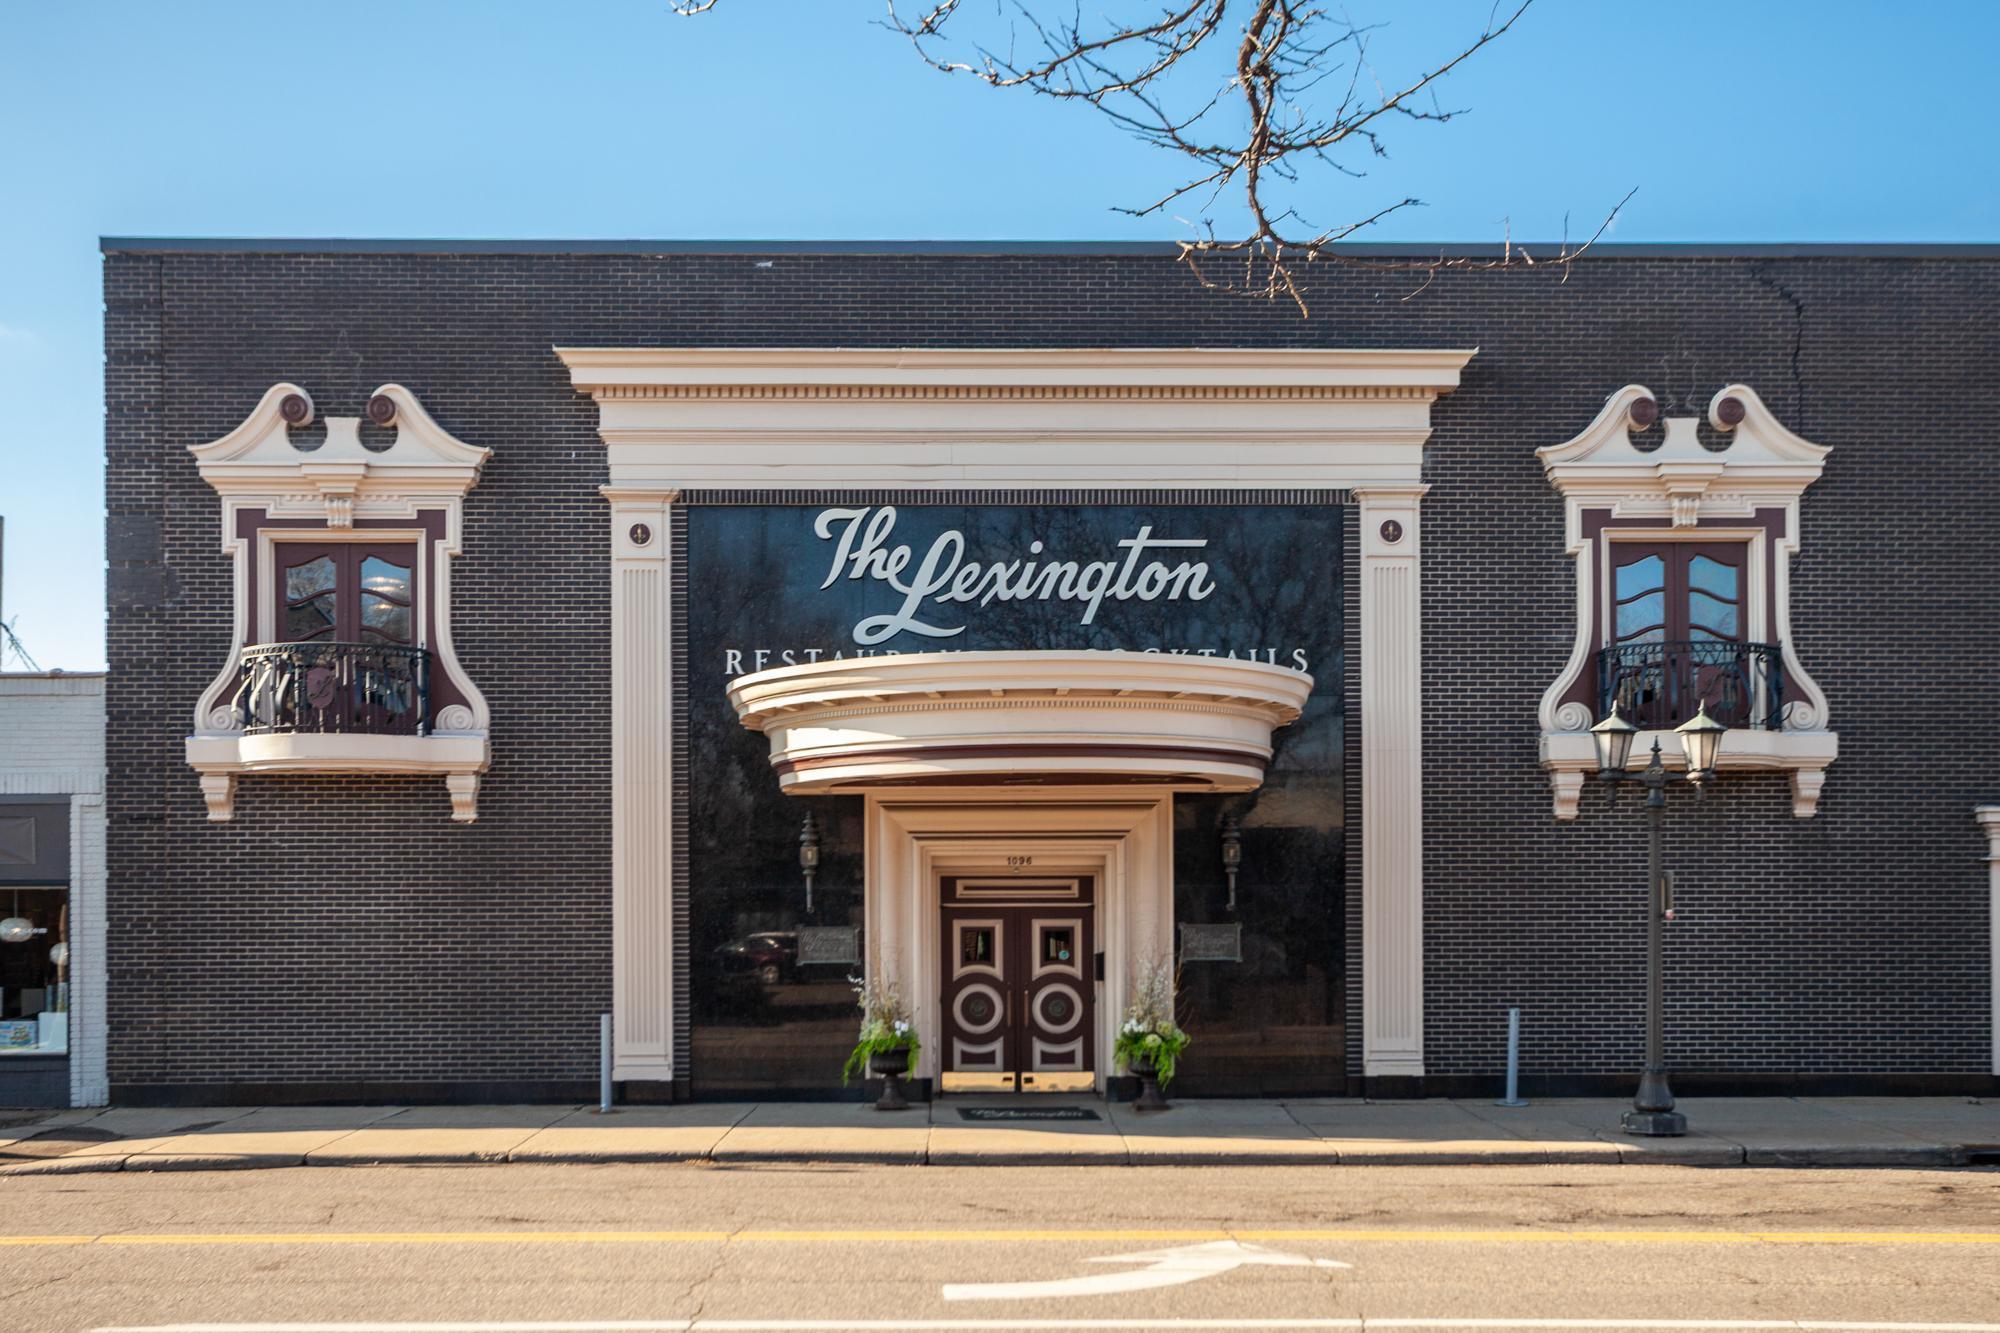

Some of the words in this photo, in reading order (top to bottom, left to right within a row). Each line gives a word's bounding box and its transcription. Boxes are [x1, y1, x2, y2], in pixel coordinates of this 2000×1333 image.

[814, 505, 912, 595] The
[852, 526, 1216, 646] Lexington
[1007, 856, 1032, 865] 1096
